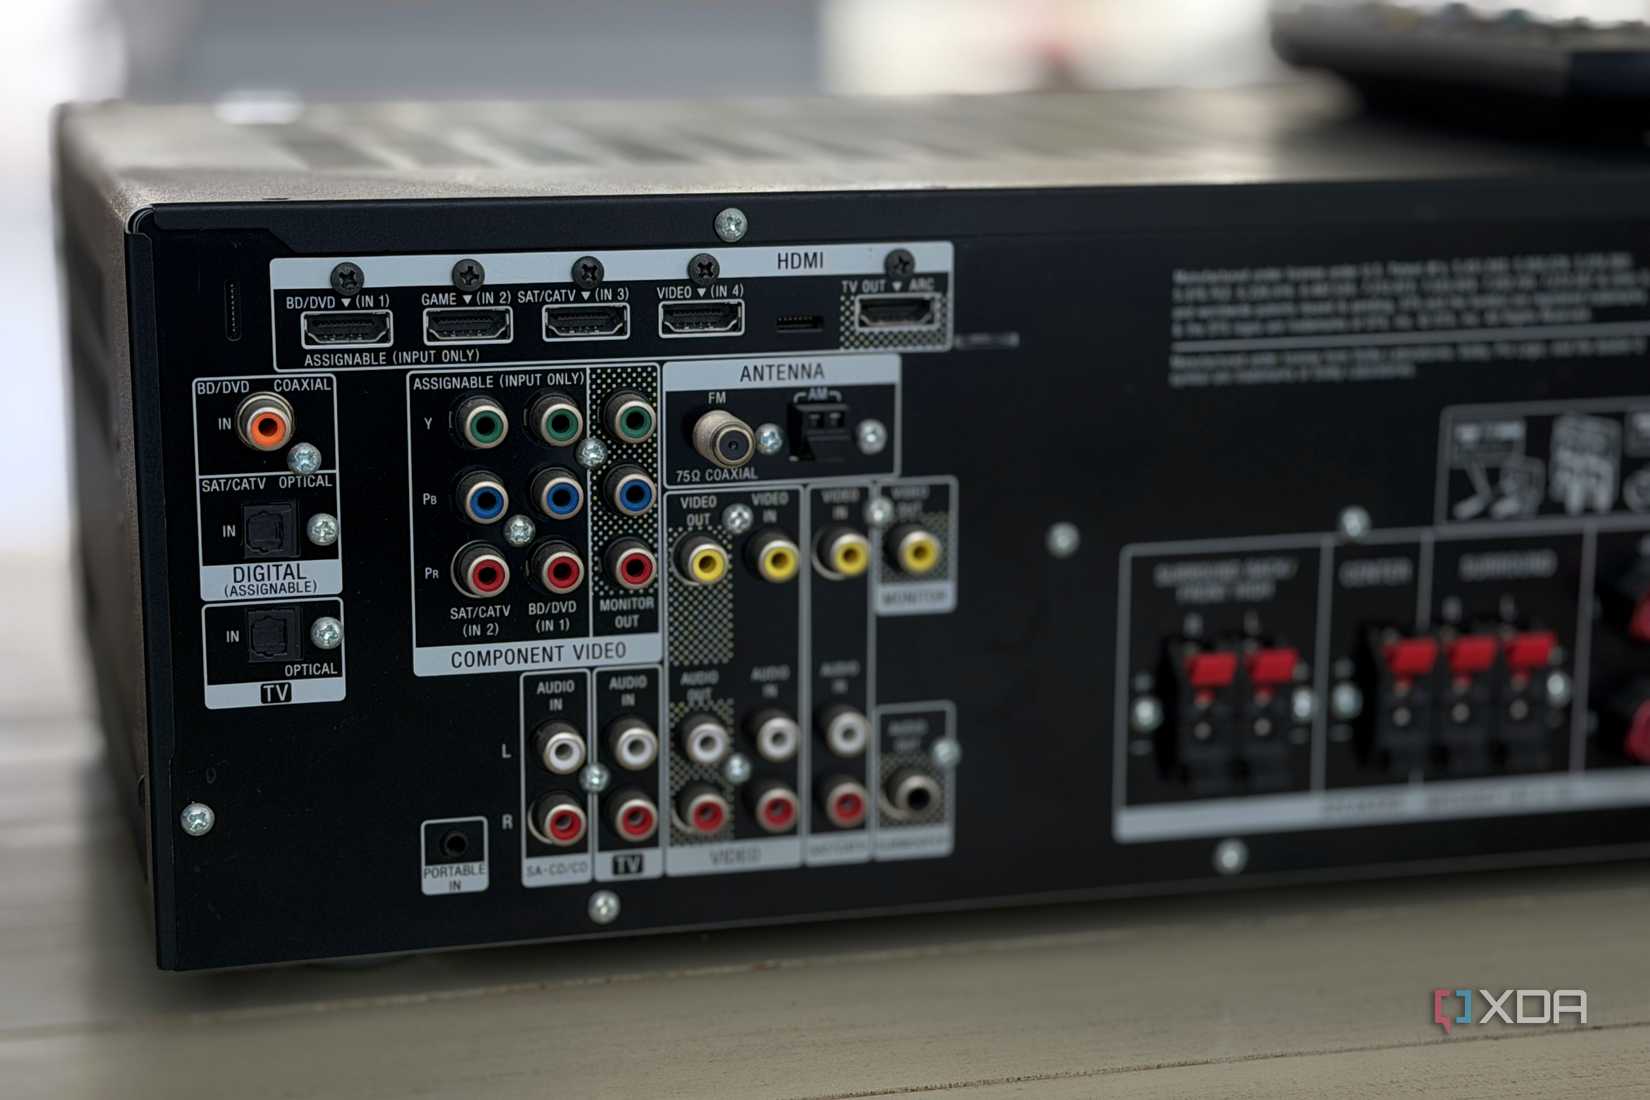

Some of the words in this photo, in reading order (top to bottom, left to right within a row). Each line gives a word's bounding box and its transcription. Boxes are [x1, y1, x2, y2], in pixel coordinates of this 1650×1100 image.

[777, 252, 824, 270] HDMI
[656, 286, 692, 299] VIDEO
[710, 285, 728, 299] (IN
[732, 283, 744, 298] 4)
[841, 280, 858, 293] TV
[862, 279, 886, 292] OUT
[909, 278, 935, 291] ARC
[286, 296, 336, 309] BD/DVD
[355, 295, 375, 309] (IN
[381, 294, 390, 308] 1)
[421, 293, 457, 306] GAME
[476, 291, 494, 305] (IN
[499, 290, 512, 304] 2)
[517, 289, 576, 303] SAT/CATV
[595, 287, 613, 302] (IN
[617, 287, 630, 301] 3)
[304, 352, 387, 367] ASSIGNABLE
[392, 350, 437, 366] (INPUT
[441, 349, 481, 364] ONLY)
[413, 376, 494, 390] ASSIGNABLE
[500, 374, 542, 389] (INPUT
[547, 371, 585, 387] ONLY)
[740, 364, 825, 383] ANTENNA
[197, 380, 250, 395] BD/DVD
[273, 378, 332, 392] COAXIAL
[708, 392, 726, 405] FM
[808, 387, 828, 400] AM
[218, 418, 231, 431] IN
[424, 417, 432, 430] Y
[705, 468, 758, 481] COAXIAL
[202, 477, 267, 492] SAT/CATV
[279, 475, 333, 489] OPTICAL
[680, 496, 717, 509] VIDEO
[752, 492, 789, 506] VIDEO
[687, 513, 711, 526] OUT
[763, 510, 777, 523] IN
[222, 525, 236, 537] IN
[233, 563, 307, 583] DIGITAL
[224, 580, 318, 597] (ASSIGNABLE)
[528, 601, 577, 616] BD/DVD
[600, 597, 655, 611] MONITOR
[450, 605, 511, 620] SAT/CATV
[536, 618, 555, 633] (IN
[560, 617, 570, 632] 1)
[615, 615, 639, 628] OUT
[226, 630, 240, 643] IN
[462, 623, 481, 638] (IN
[486, 622, 499, 637] 2)
[451, 645, 564, 669] COMPONENT
[573, 641, 626, 661] VIDEO
[285, 663, 338, 677] OPTICAL
[609, 676, 647, 690] AUDIO
[680, 671, 719, 685] AUDIO
[263, 684, 289, 703] TV
[537, 680, 575, 694] AUDIO
[550, 699, 563, 711] IN
[621, 694, 635, 706] IN
[502, 744, 512, 758] L
[502, 815, 513, 829] R
[615, 857, 641, 873] TV
[424, 865, 486, 880] PORTABLE
[450, 880, 462, 891] IN
